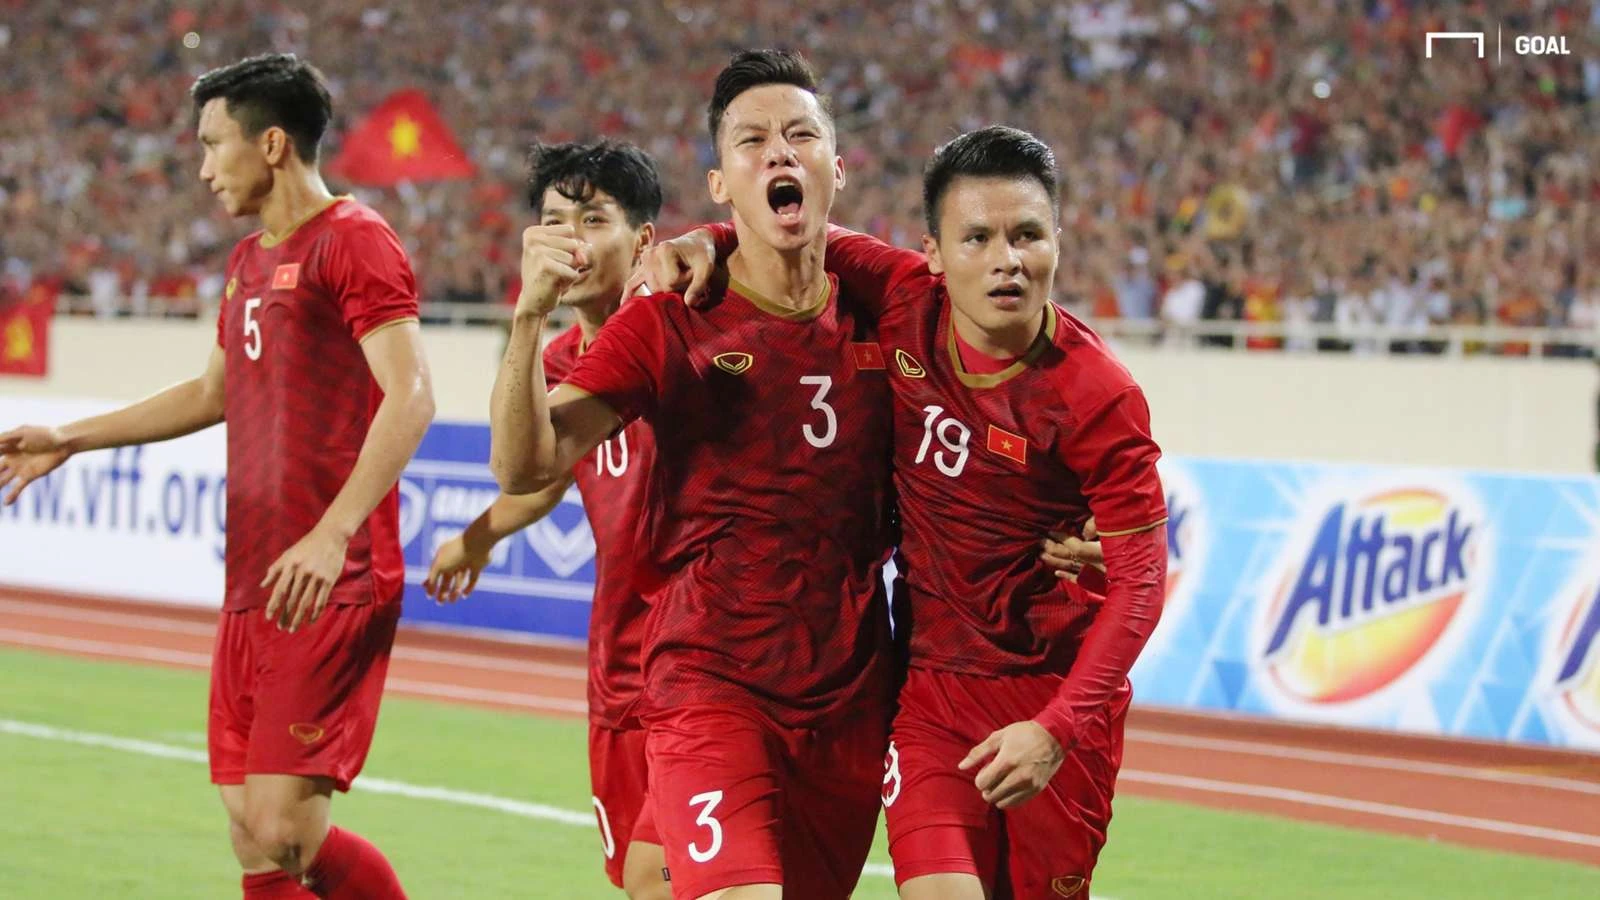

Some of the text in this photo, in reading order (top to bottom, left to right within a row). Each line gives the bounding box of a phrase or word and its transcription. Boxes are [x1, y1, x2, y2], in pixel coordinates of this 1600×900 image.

[243, 298, 262, 361] 5
[800, 375, 838, 448] 3
[915, 405, 971, 478] 19
[596, 429, 629, 478] 10
[1264, 501, 1473, 658] Attack
[687, 790, 723, 863] 3
